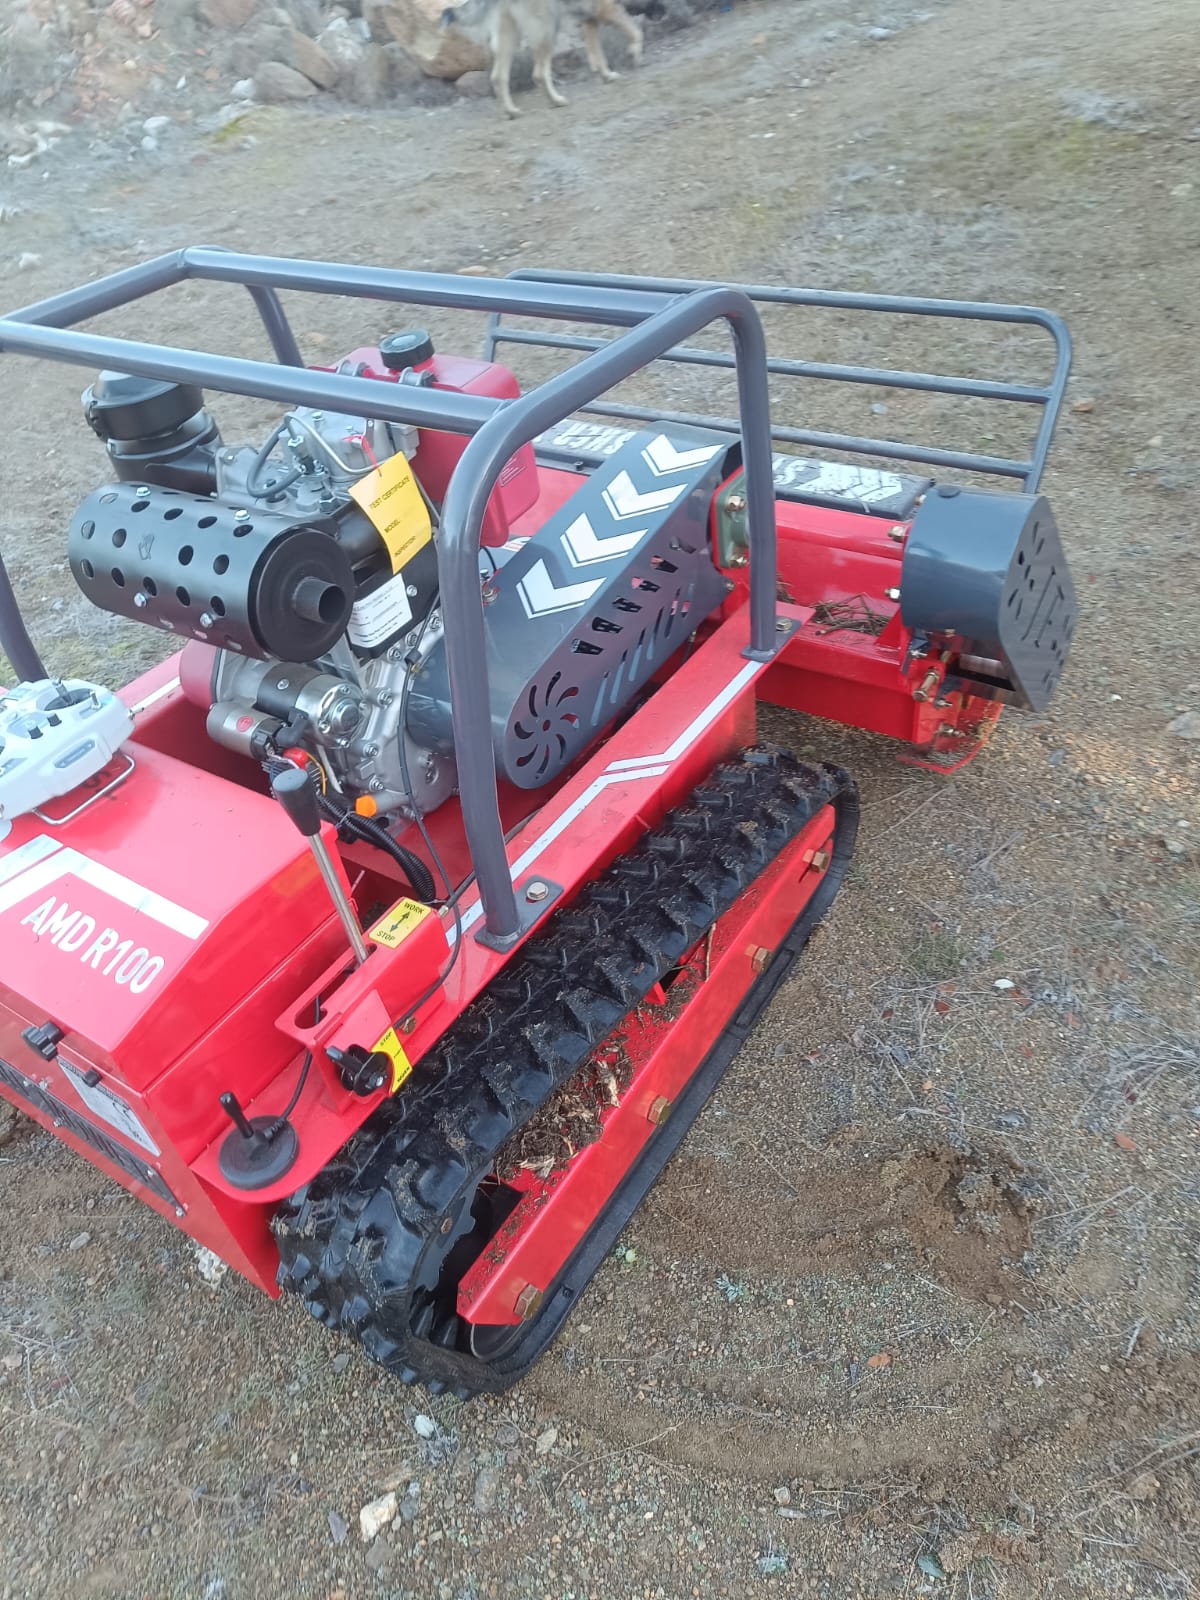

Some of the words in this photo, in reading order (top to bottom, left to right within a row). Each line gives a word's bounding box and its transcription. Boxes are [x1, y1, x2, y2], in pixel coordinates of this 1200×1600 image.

[382, 476, 410, 501] CERTIFICATE
[404, 902, 424, 914] WORK
[377, 931, 395, 942] STOP
[21, 896, 96, 951] AMD
[80, 928, 164, 993] R100
[380, 1031, 392, 1046] STOP
